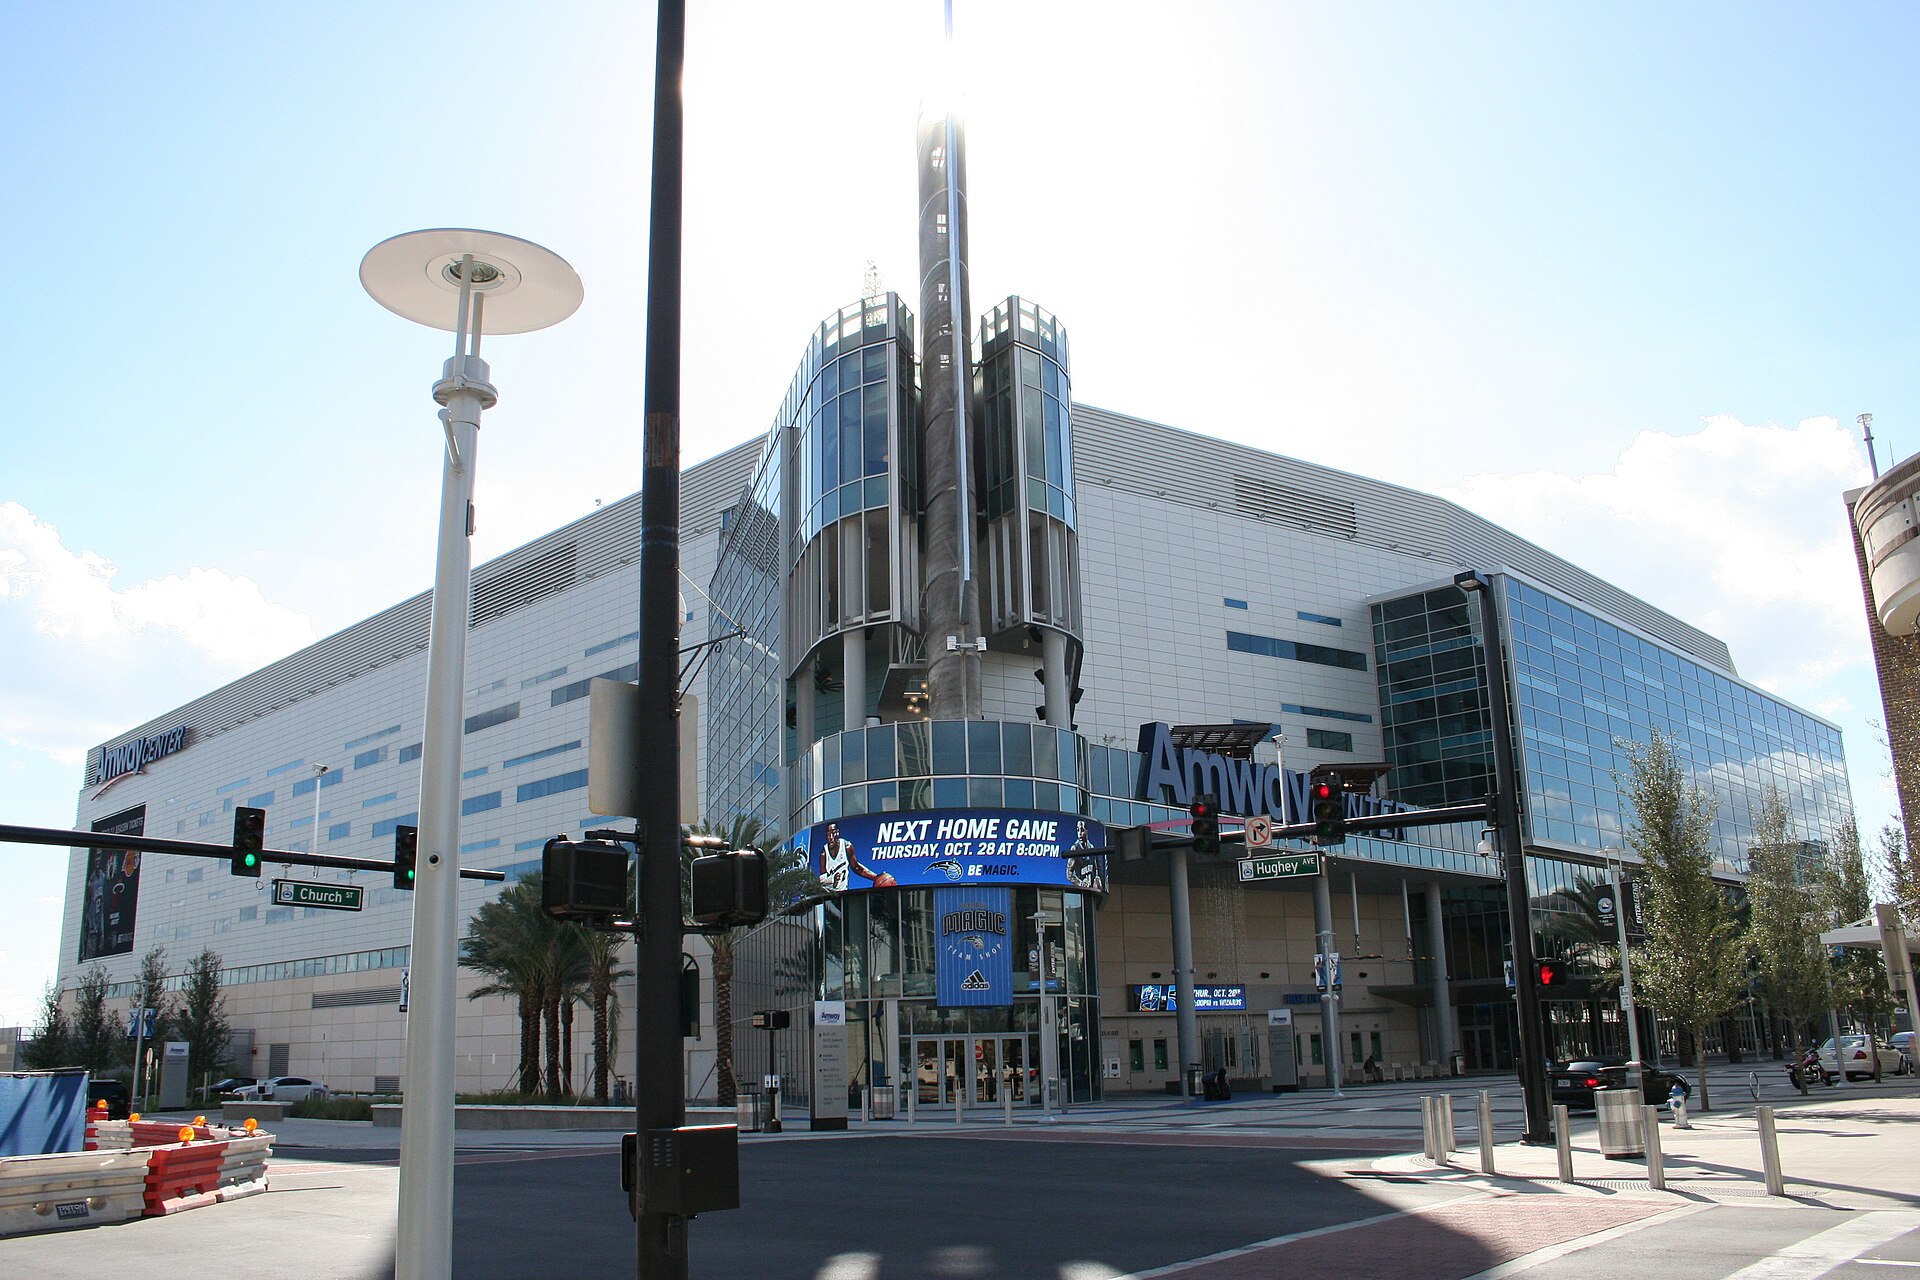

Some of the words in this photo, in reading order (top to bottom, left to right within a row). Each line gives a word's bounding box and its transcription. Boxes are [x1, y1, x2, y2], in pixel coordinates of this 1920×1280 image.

[95, 737, 146, 784] Amway
[142, 725, 186, 765] CENTER
[1136, 721, 1316, 823] Amway
[877, 819, 932, 843] NEXT
[936, 818, 1000, 839] HOME
[1005, 819, 1058, 841] GAME
[871, 843, 941, 860] THURSDAY,
[944, 842, 972, 857] OCT.
[978, 842, 996, 855] 28
[997, 842, 1014, 856] AT
[1016, 842, 1060, 858] 8:00PM
[1256, 861, 1298, 876] Hughey
[1302, 857, 1315, 865] AVE
[300, 887, 342, 903] Church
[345, 891, 354, 899] ST
[943, 910, 1006, 936] MAGIC
[947, 945, 971, 960] TEAM
[980, 943, 1002, 960] SHOP
[961, 982, 990, 990] adidas
[1213, 989, 1226, 998] OCT.
[57, 1203, 86, 1211] TRITON
